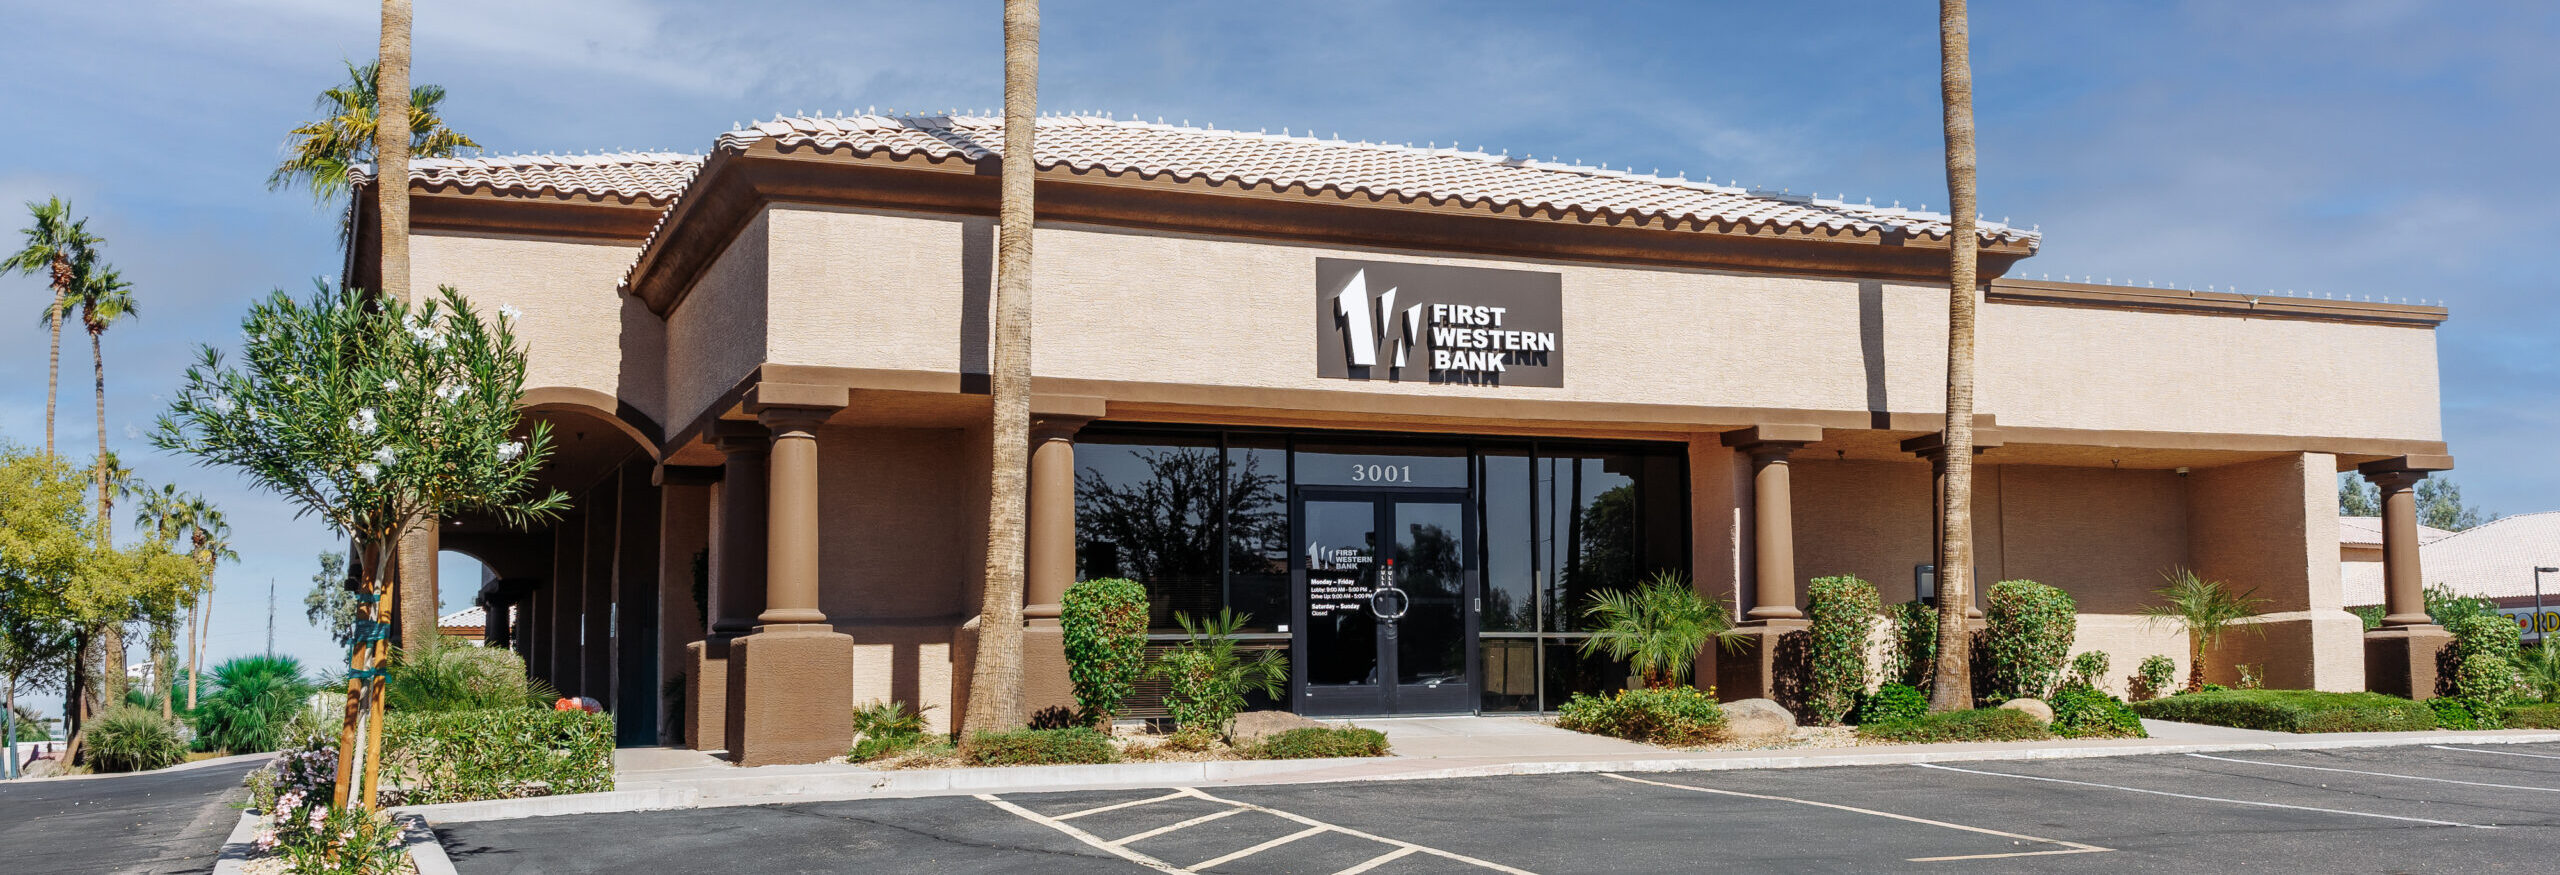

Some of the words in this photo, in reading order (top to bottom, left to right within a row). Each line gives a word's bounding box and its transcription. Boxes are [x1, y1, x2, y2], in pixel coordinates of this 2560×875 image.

[1433, 303, 1506, 327] FIRST
[1433, 326, 1555, 351] WESTERN
[1434, 351, 1506, 372] BANK
[1352, 464, 1412, 483] 3001
